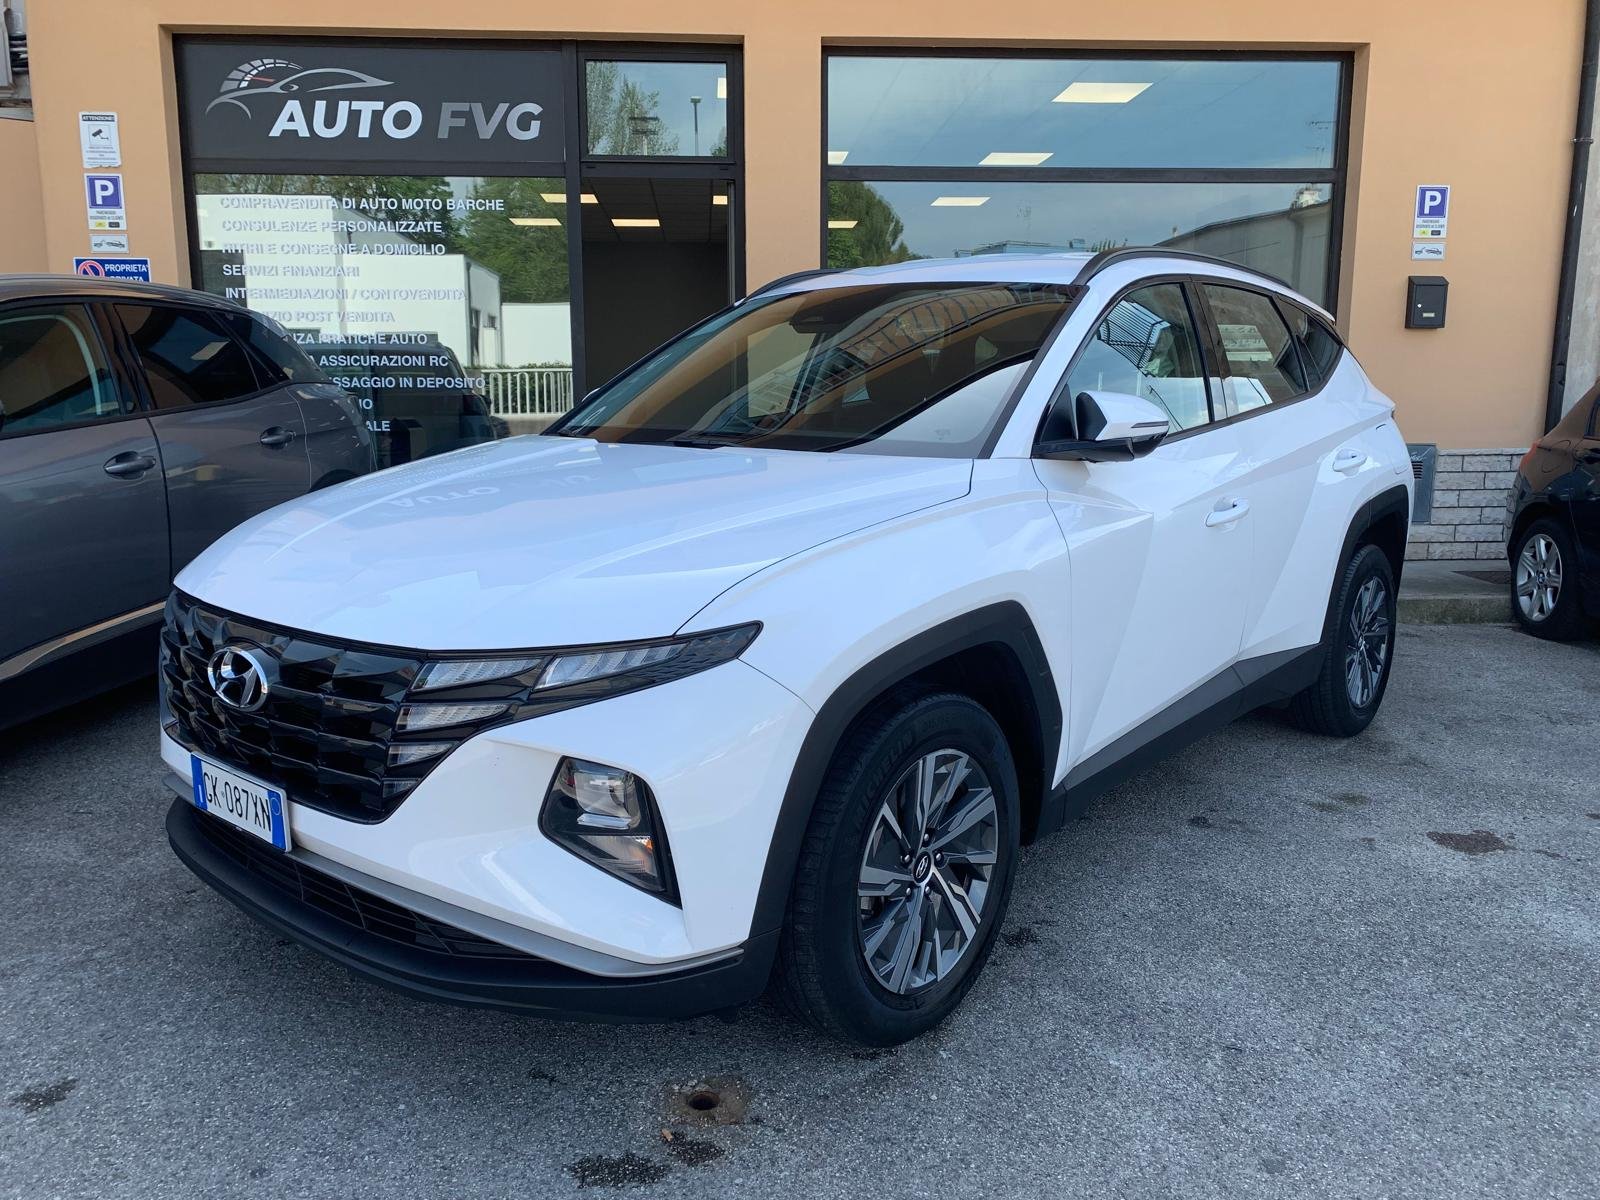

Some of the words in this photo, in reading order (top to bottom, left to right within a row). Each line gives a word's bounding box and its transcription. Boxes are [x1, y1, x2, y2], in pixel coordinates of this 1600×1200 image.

[268, 100, 422, 138] AUTO
[437, 102, 543, 140] FVG
[94, 179, 114, 204] P
[220, 198, 338, 211] COMPRAVENDITA
[342, 199, 356, 210] DI
[359, 199, 398, 210] AUTO
[402, 199, 443, 211] MOTO
[446, 199, 505, 211] BARCHE
[1424, 191, 1441, 214] P
[221, 220, 317, 232] CONSULENZE
[320, 221, 442, 233] PERSONALIZZATE
[221, 243, 264, 255] RITIRI
[267, 244, 278, 255] E
[281, 244, 357, 255] CONSEGNE
[361, 244, 372, 255] A
[374, 244, 446, 255] DOMICILIO
[222, 264, 279, 277] SERVIZI
[282, 265, 360, 277] FINANZIARI
[225, 287, 349, 300] INTERMEDIAZIONI
[360, 288, 466, 301] CONTOVENDITA
[295, 311, 334, 322] POST
[338, 311, 396, 323] VENDITA
[319, 333, 387, 344] PRATICHE
[390, 334, 428, 345] AUTO
[319, 355, 426, 367] ASSICURAZIONI
[429, 355, 449, 367] RC
[330, 377, 396, 388] SSAGGIO
[400, 377, 413, 388] IN
[416, 377, 486, 389] DEPOSITO
